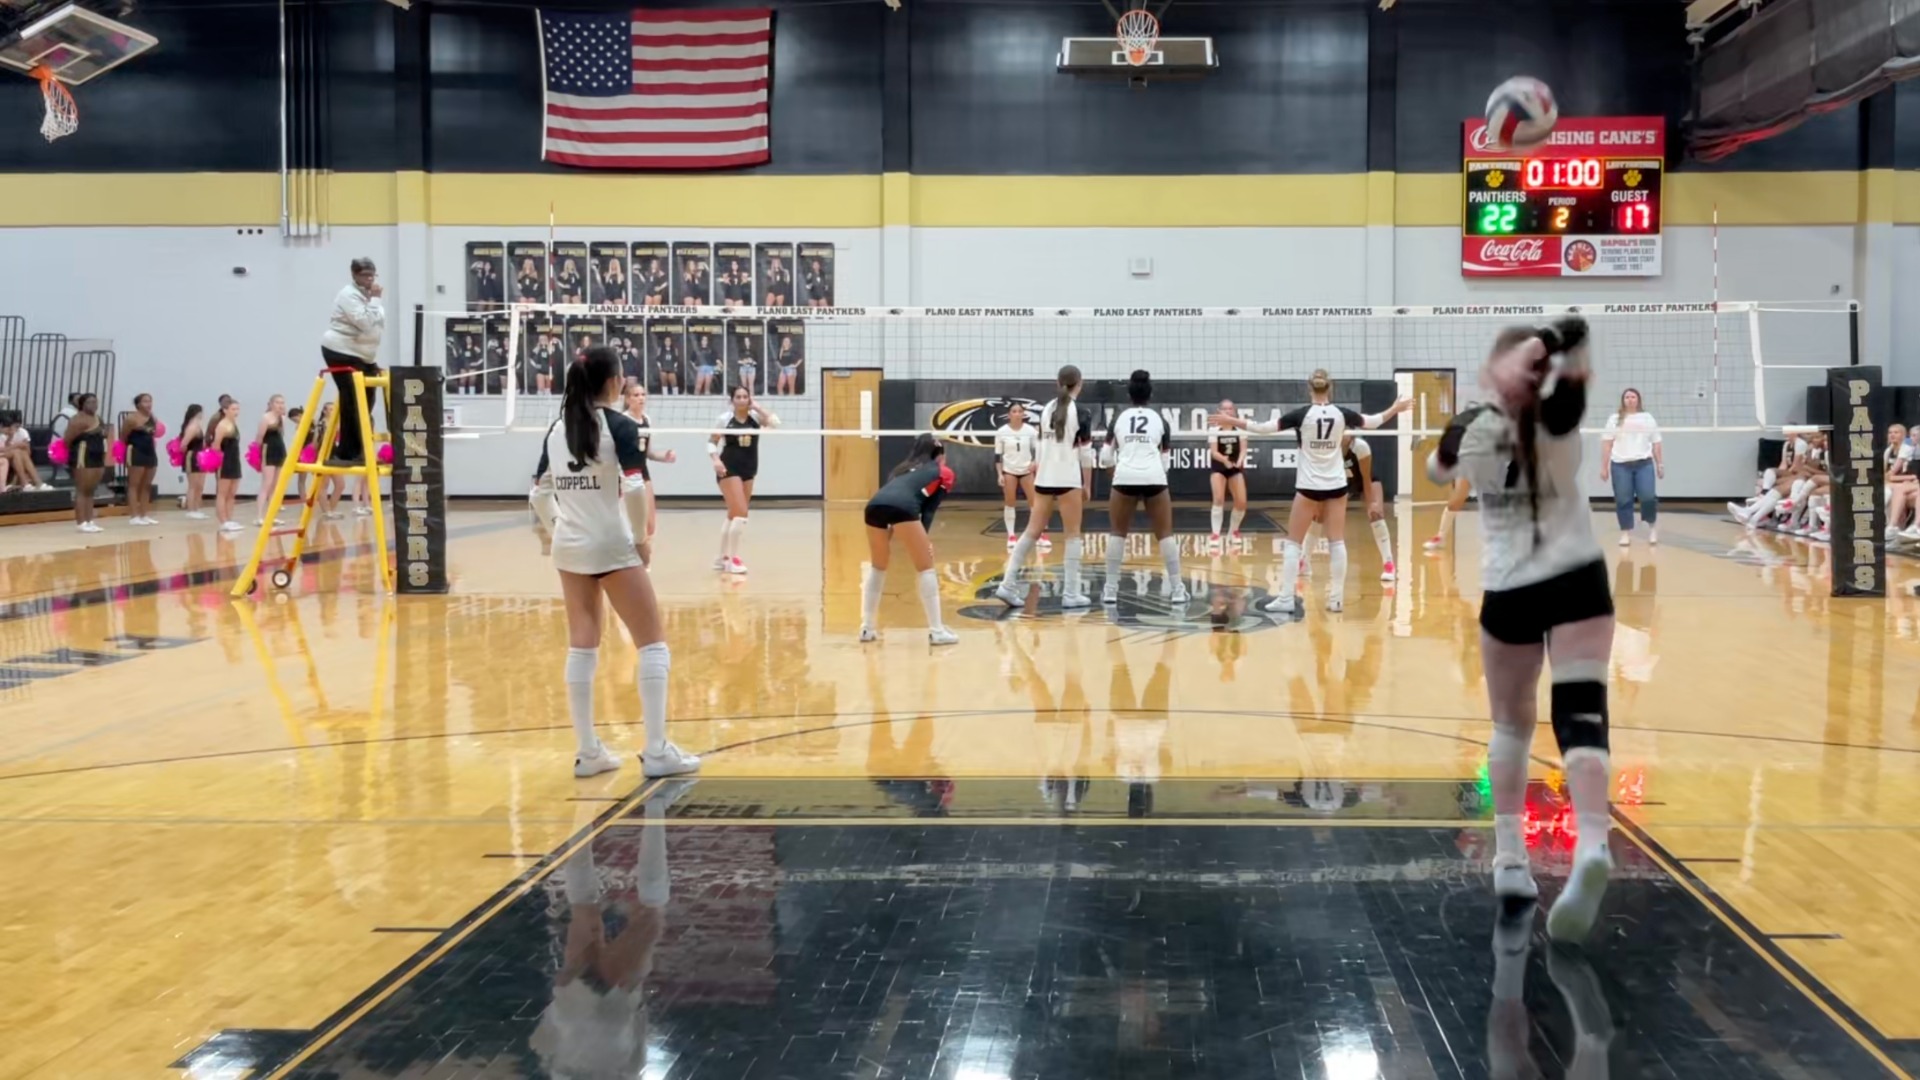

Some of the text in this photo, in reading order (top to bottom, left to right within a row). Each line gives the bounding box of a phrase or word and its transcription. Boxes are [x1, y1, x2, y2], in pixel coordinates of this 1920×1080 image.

[1599, 130, 1656, 145] CANE'S
[1526, 159, 1601, 187] 01:00
[1468, 191, 1527, 204] PANTHERS
[1548, 197, 1577, 206] PERIOD
[1610, 190, 1649, 203] GUEST
[1483, 204, 1518, 232] 22
[1555, 207, 1570, 229] 2
[1624, 203, 1650, 229] 17
[1480, 239, 1545, 261] Coca-Cola
[588, 305, 698, 315] PLANO EAST PANTHERS
[757, 306, 866, 316] PLANO EAST PANTHERS
[925, 308, 1034, 317] PLANO EAST PANTHERS
[1093, 308, 1203, 317] PLANO EAST PANTHERS
[1262, 307, 1372, 317] PLANO EAST PANTHERS
[1432, 306, 1544, 316] PLANO EAST PANTHERS
[1604, 303, 1716, 313] PLANO EAST PANTHERS
[1129, 416, 1149, 434] 12
[1316, 417, 1335, 440] 17
[1016, 442, 1021, 452] 1
[1168, 448, 1190, 469] HIS
[402, 378, 430, 587] PANTHERS
[555, 474, 601, 491] COPPELL
[1848, 379, 1876, 591] PANTHERS
